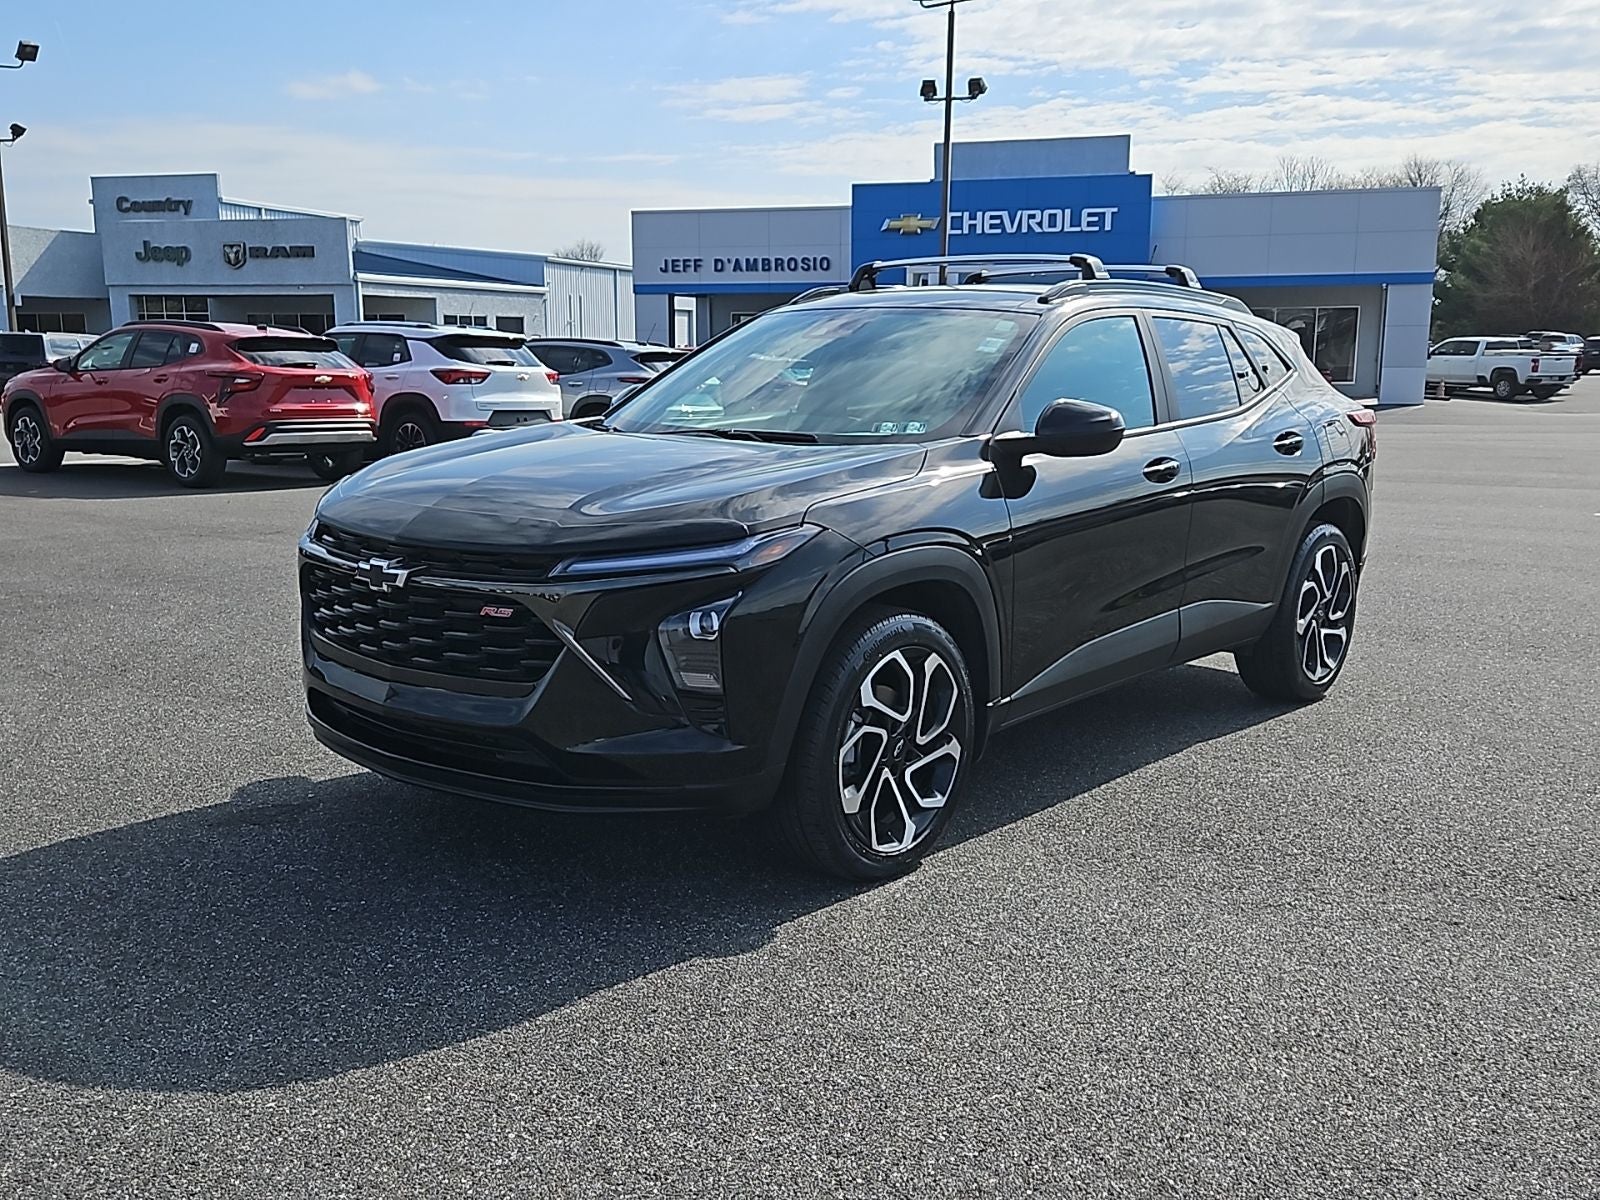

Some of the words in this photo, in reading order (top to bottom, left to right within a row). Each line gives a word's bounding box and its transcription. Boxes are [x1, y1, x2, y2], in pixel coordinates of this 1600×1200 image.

[116, 196, 193, 215] Country
[947, 207, 1118, 235] CHEVROLET
[135, 240, 192, 267] Jeep
[249, 246, 315, 258] RAM
[659, 258, 703, 273] JEFF
[713, 256, 831, 273] D'AMBROSIO
[480, 606, 514, 617] RS
